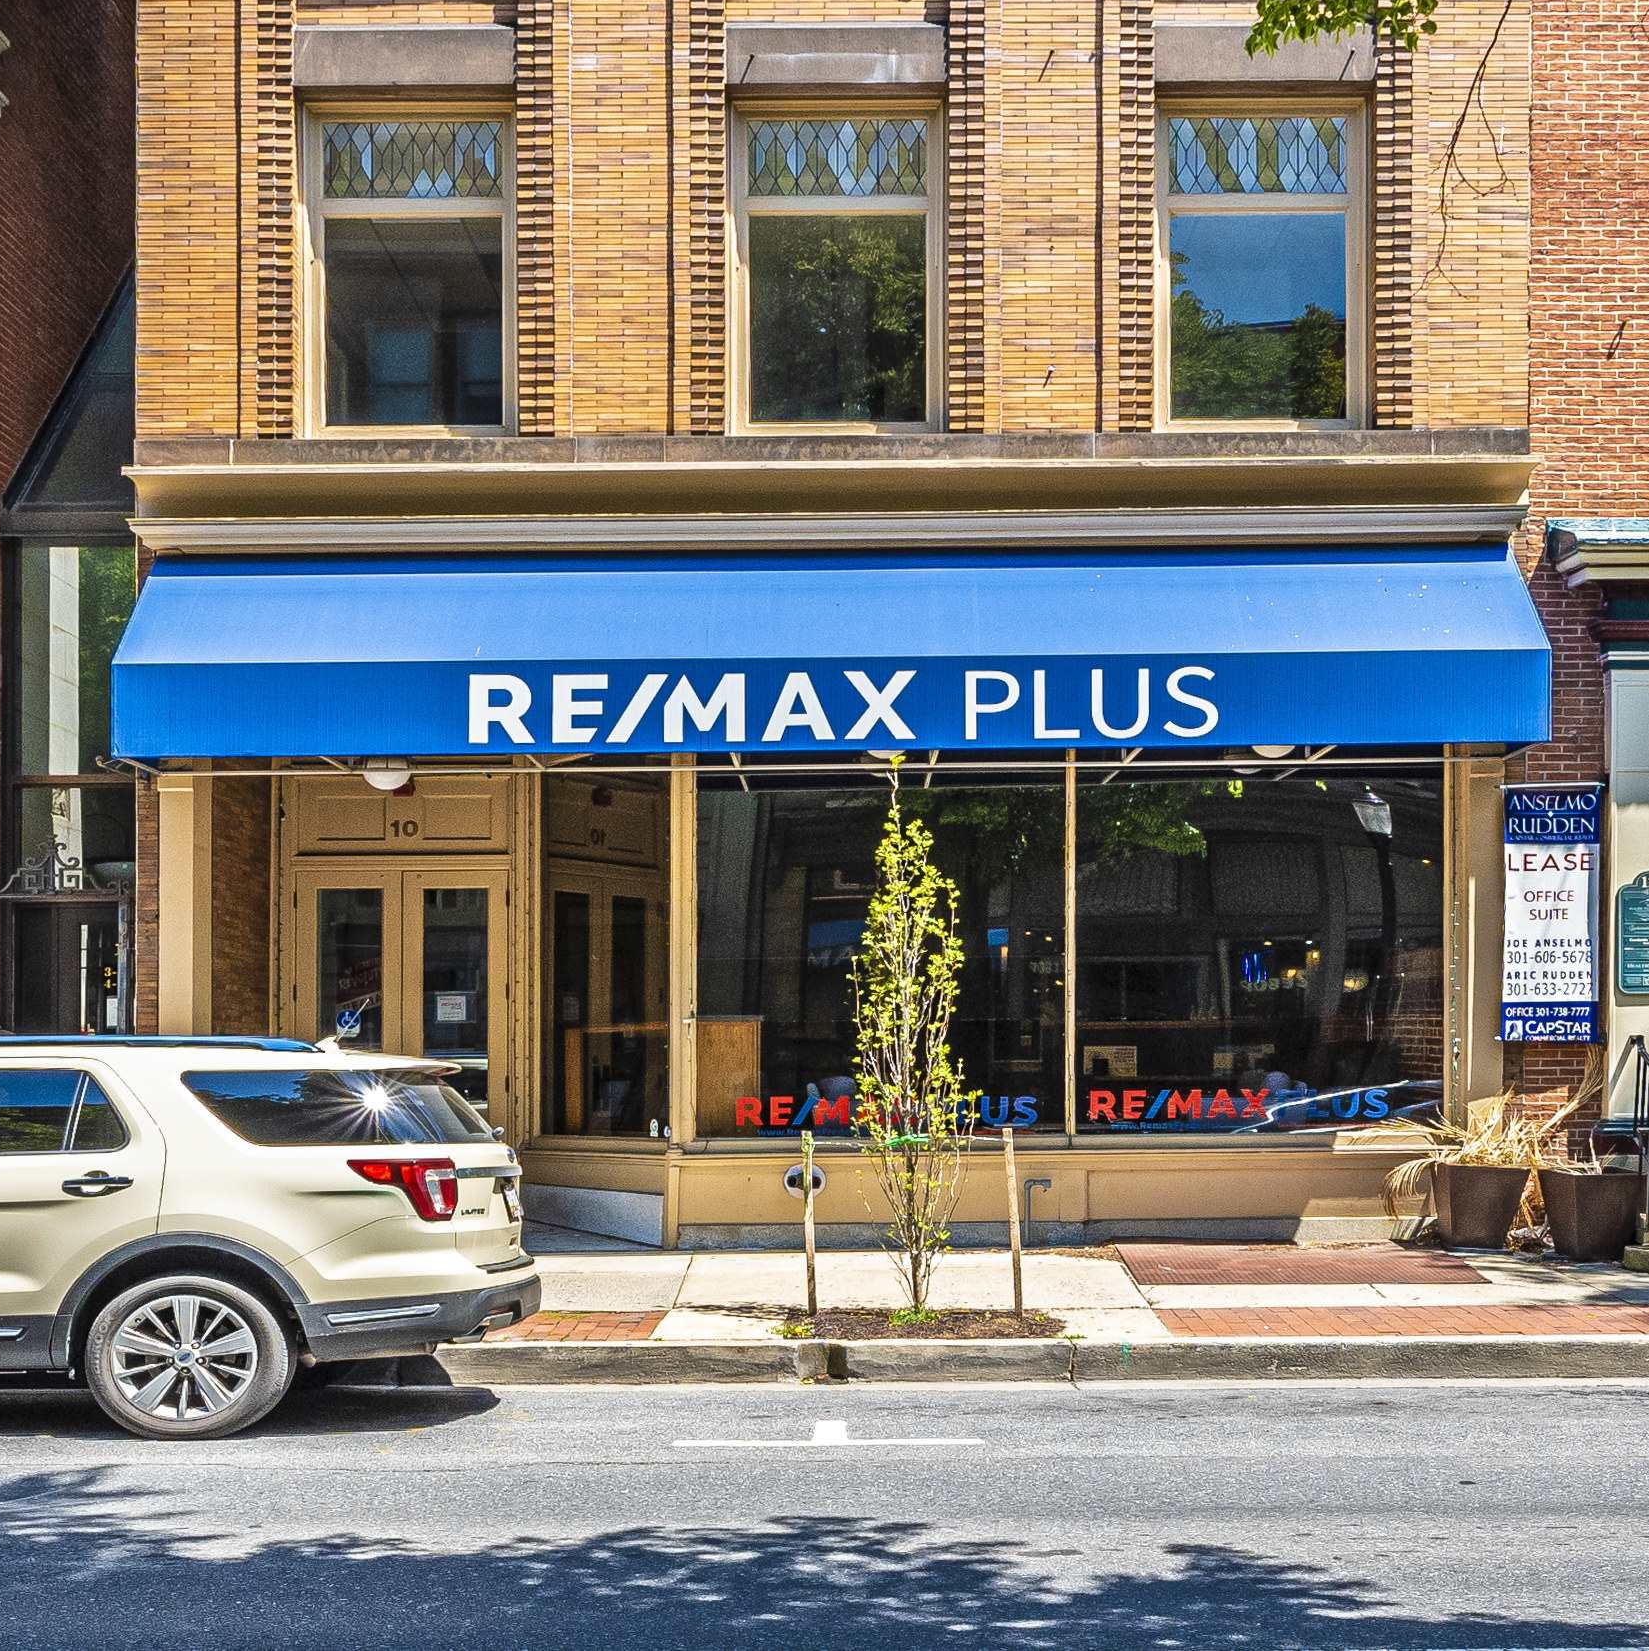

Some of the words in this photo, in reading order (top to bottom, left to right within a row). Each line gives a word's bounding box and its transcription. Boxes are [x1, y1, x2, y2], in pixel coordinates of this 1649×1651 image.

[467, 669, 917, 745] RE/MAX
[964, 665, 1219, 740] PLUS
[1508, 793, 1597, 811] ANSELMO
[390, 819, 419, 838] 10
[1508, 817, 1595, 834] RUDDEN
[1508, 853, 1595, 872] LEASE
[1523, 890, 1575, 903] OFFICE
[1529, 908, 1569, 921] SUITE
[1507, 939, 1528, 948] JOE
[1534, 938, 1592, 948] ANSELMO
[1506, 950, 1592, 964] 301-606-5678
[1506, 971, 1537, 980] ARIC
[1542, 971, 1592, 980] RUDDEN
[1506, 982, 1592, 996] 301-633-2727
[1505, 1006, 1534, 1018] OFFICE
[1088, 1088, 1269, 1120] RE/MAX
